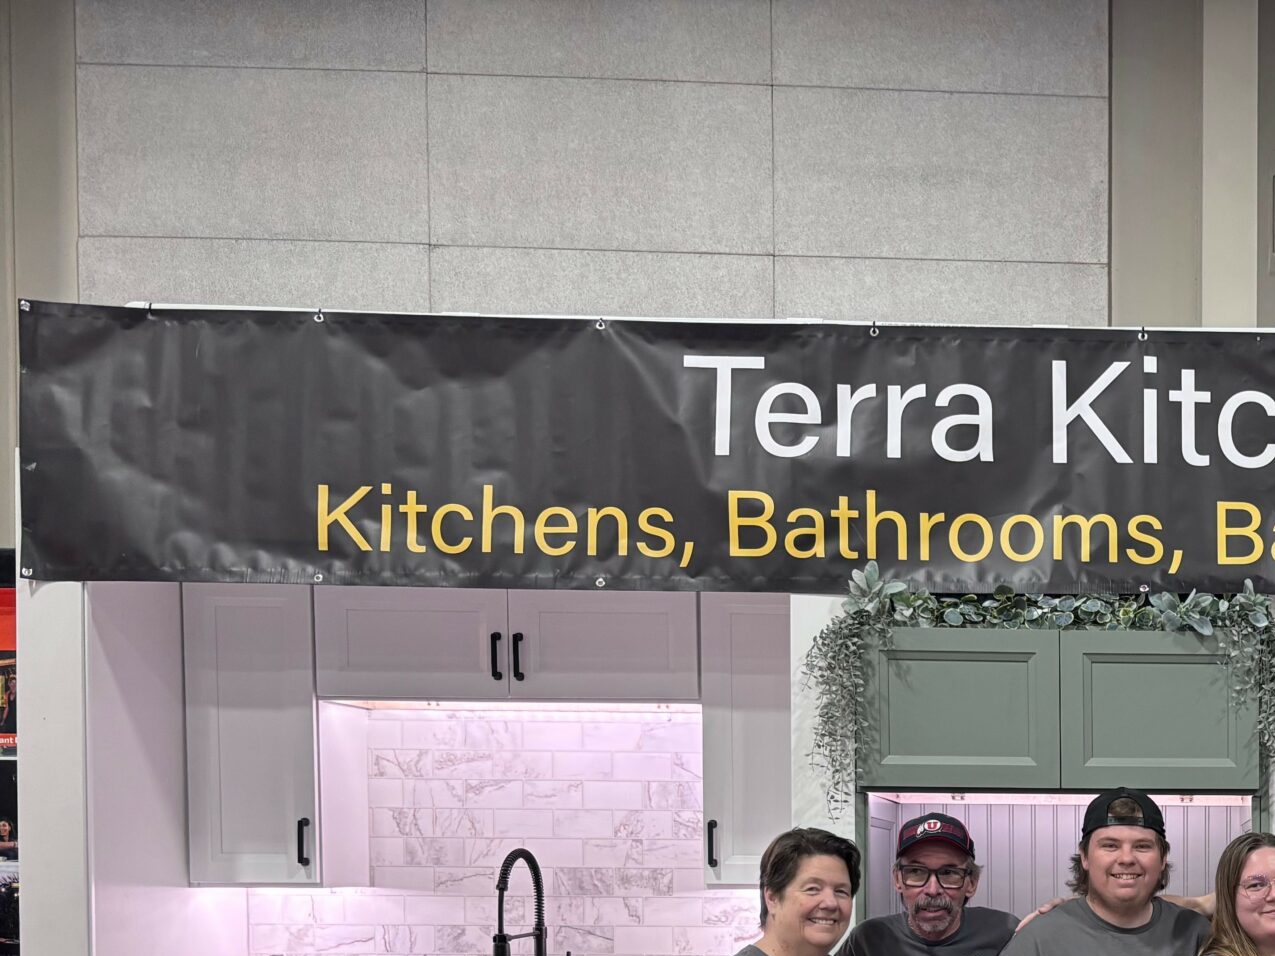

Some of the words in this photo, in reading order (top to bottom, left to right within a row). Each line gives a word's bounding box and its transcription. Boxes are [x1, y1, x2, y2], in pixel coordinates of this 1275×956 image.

[683, 354, 994, 462] Terra
[317, 484, 696, 567] Kitchens,
[728, 490, 1183, 574] Bathrooms,
